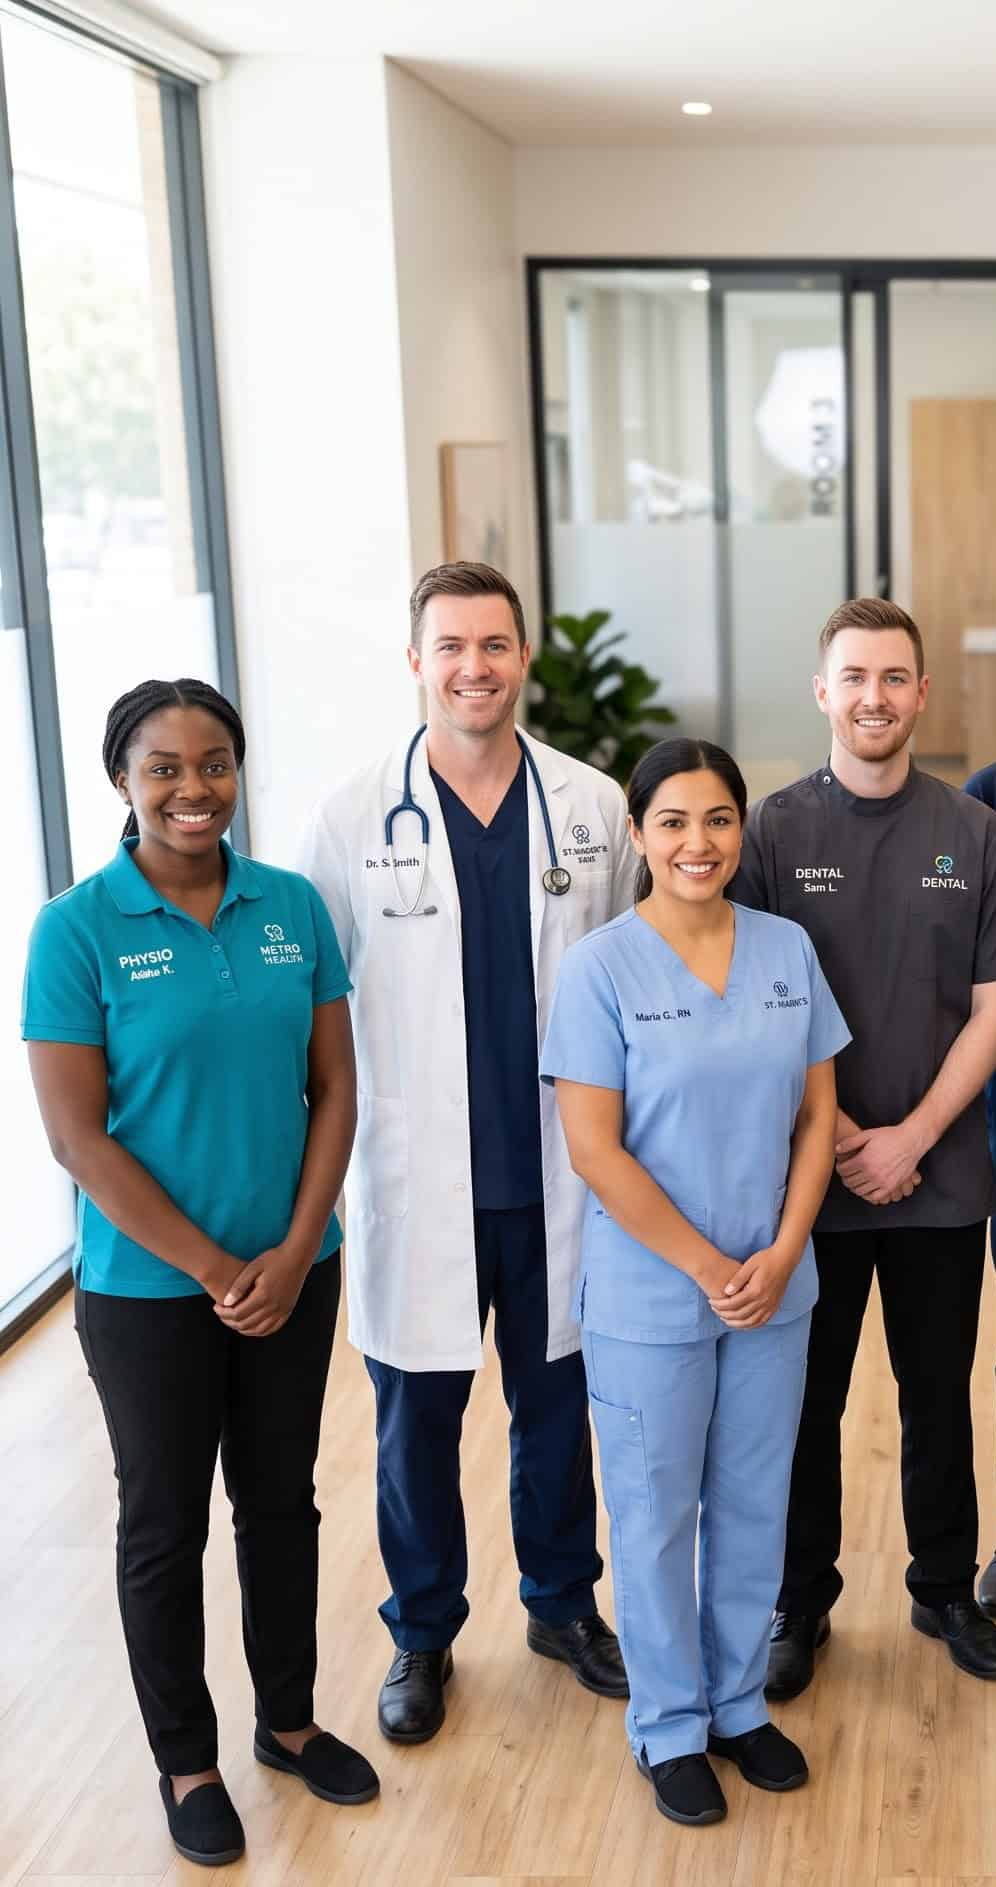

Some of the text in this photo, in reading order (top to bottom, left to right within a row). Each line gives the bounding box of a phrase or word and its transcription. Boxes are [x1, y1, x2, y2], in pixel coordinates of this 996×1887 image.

[810, 423, 836, 516] ROOM
[366, 859, 379, 869] Dr.
[795, 867, 845, 880] DENTAL
[804, 882, 826, 893] Sam
[921, 877, 968, 890] DENTAL
[259, 943, 301, 956] METRO
[119, 948, 173, 969] PHYSIO
[161, 964, 175, 975] K.
[764, 1000, 777, 1010] ST.
[635, 1012, 661, 1022] Maria
[677, 1009, 692, 1019] RN
